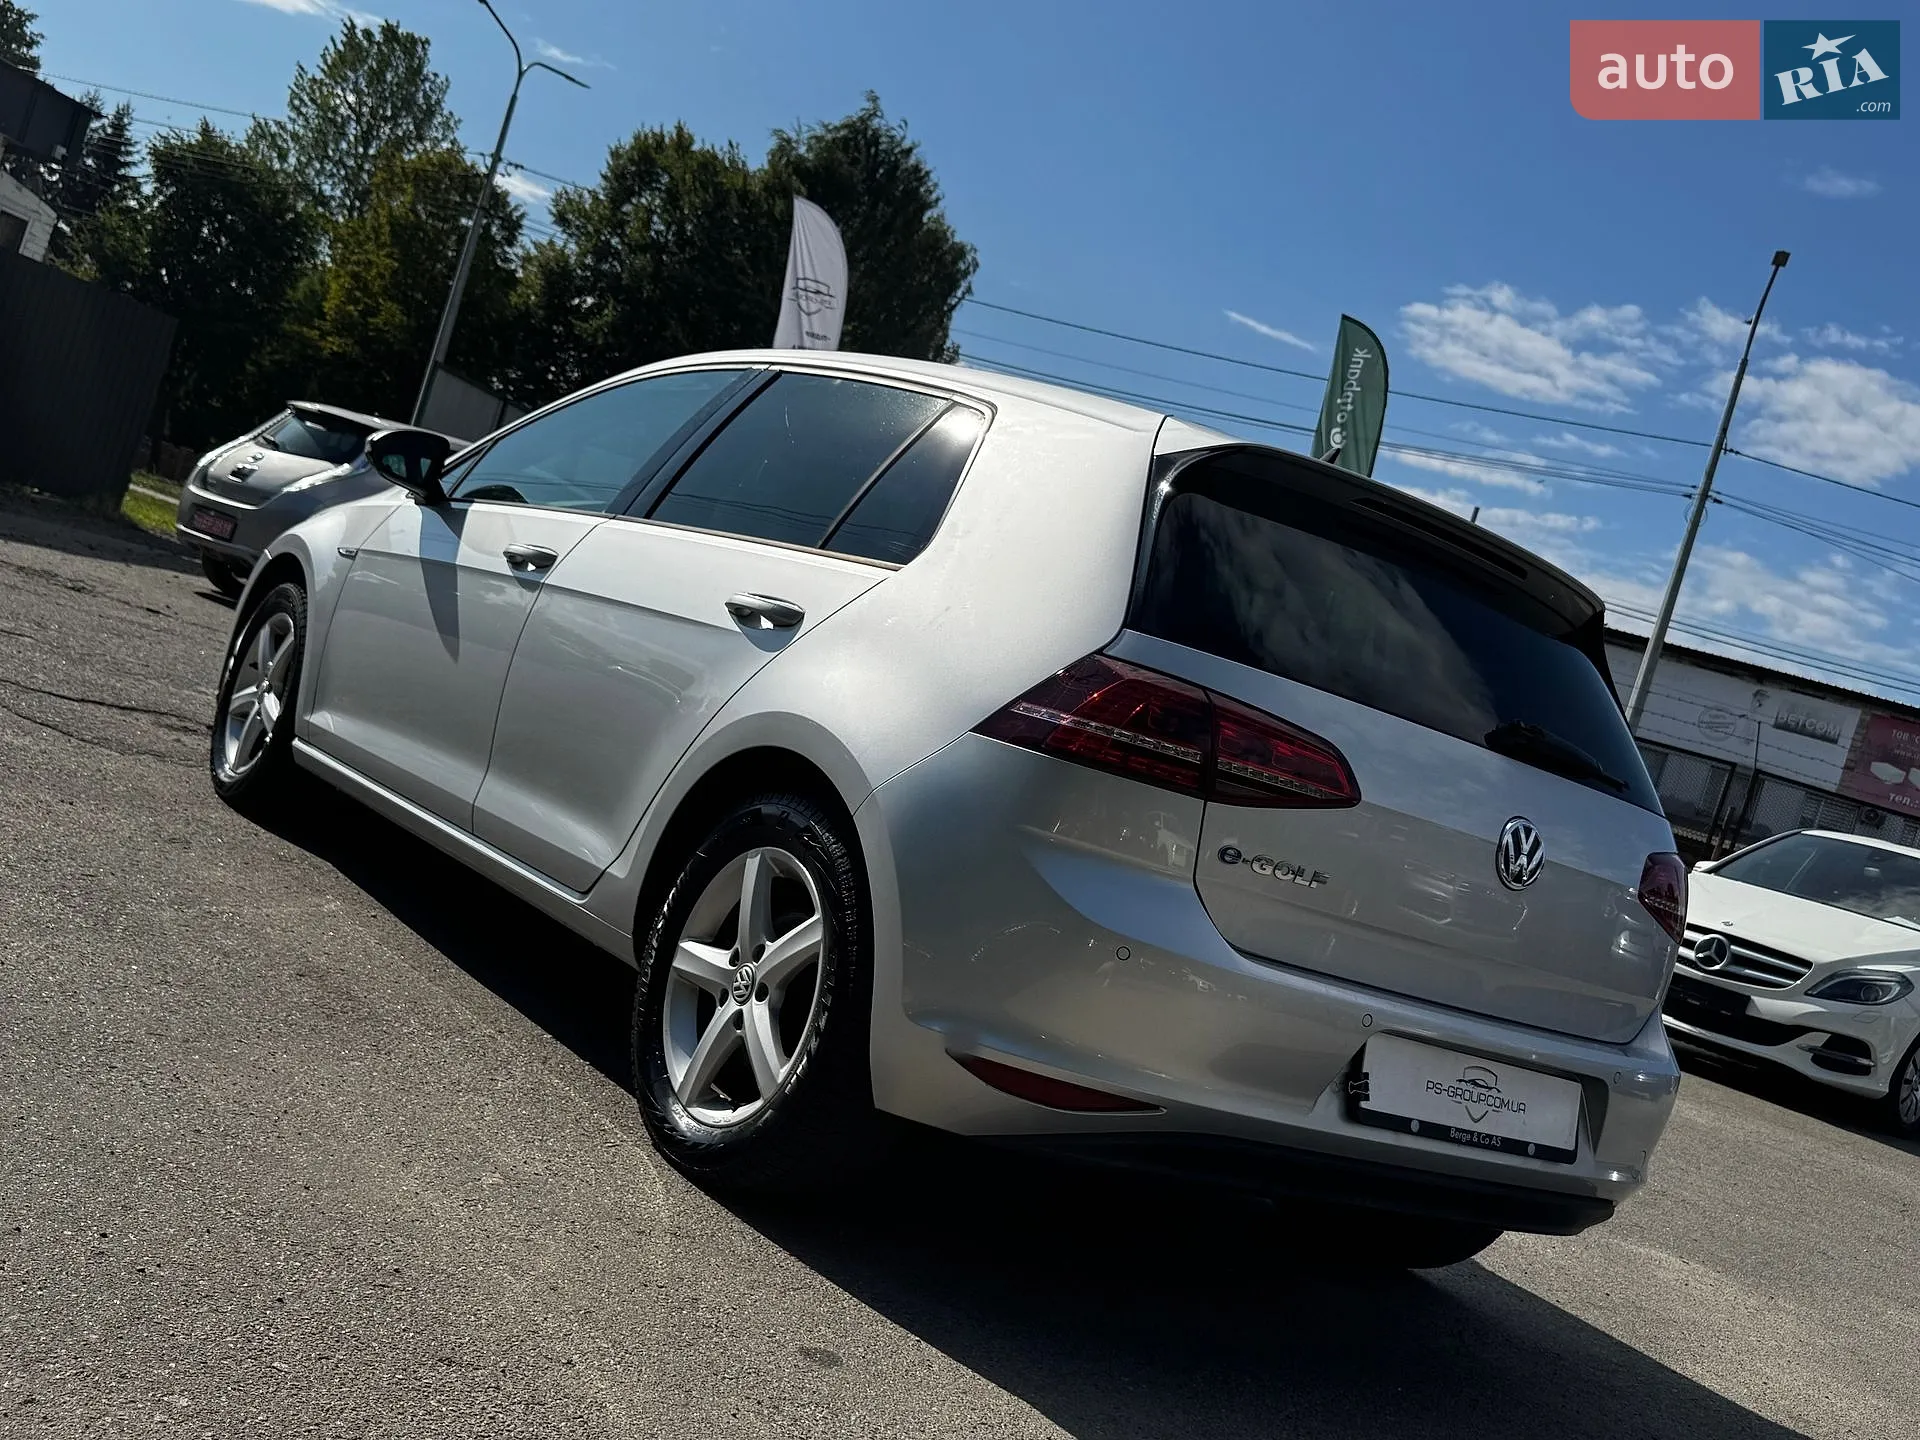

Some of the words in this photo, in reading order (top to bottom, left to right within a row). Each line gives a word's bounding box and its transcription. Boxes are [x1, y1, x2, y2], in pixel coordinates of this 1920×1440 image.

[1217, 845, 1332, 889] e-GOLF
[1425, 1079, 1527, 1115] PS-GROUP.COM.UA
[1472, 1131, 1479, 1143] &
[1480, 1133, 1490, 1145] Co
[1490, 1135, 1502, 1147] AS
